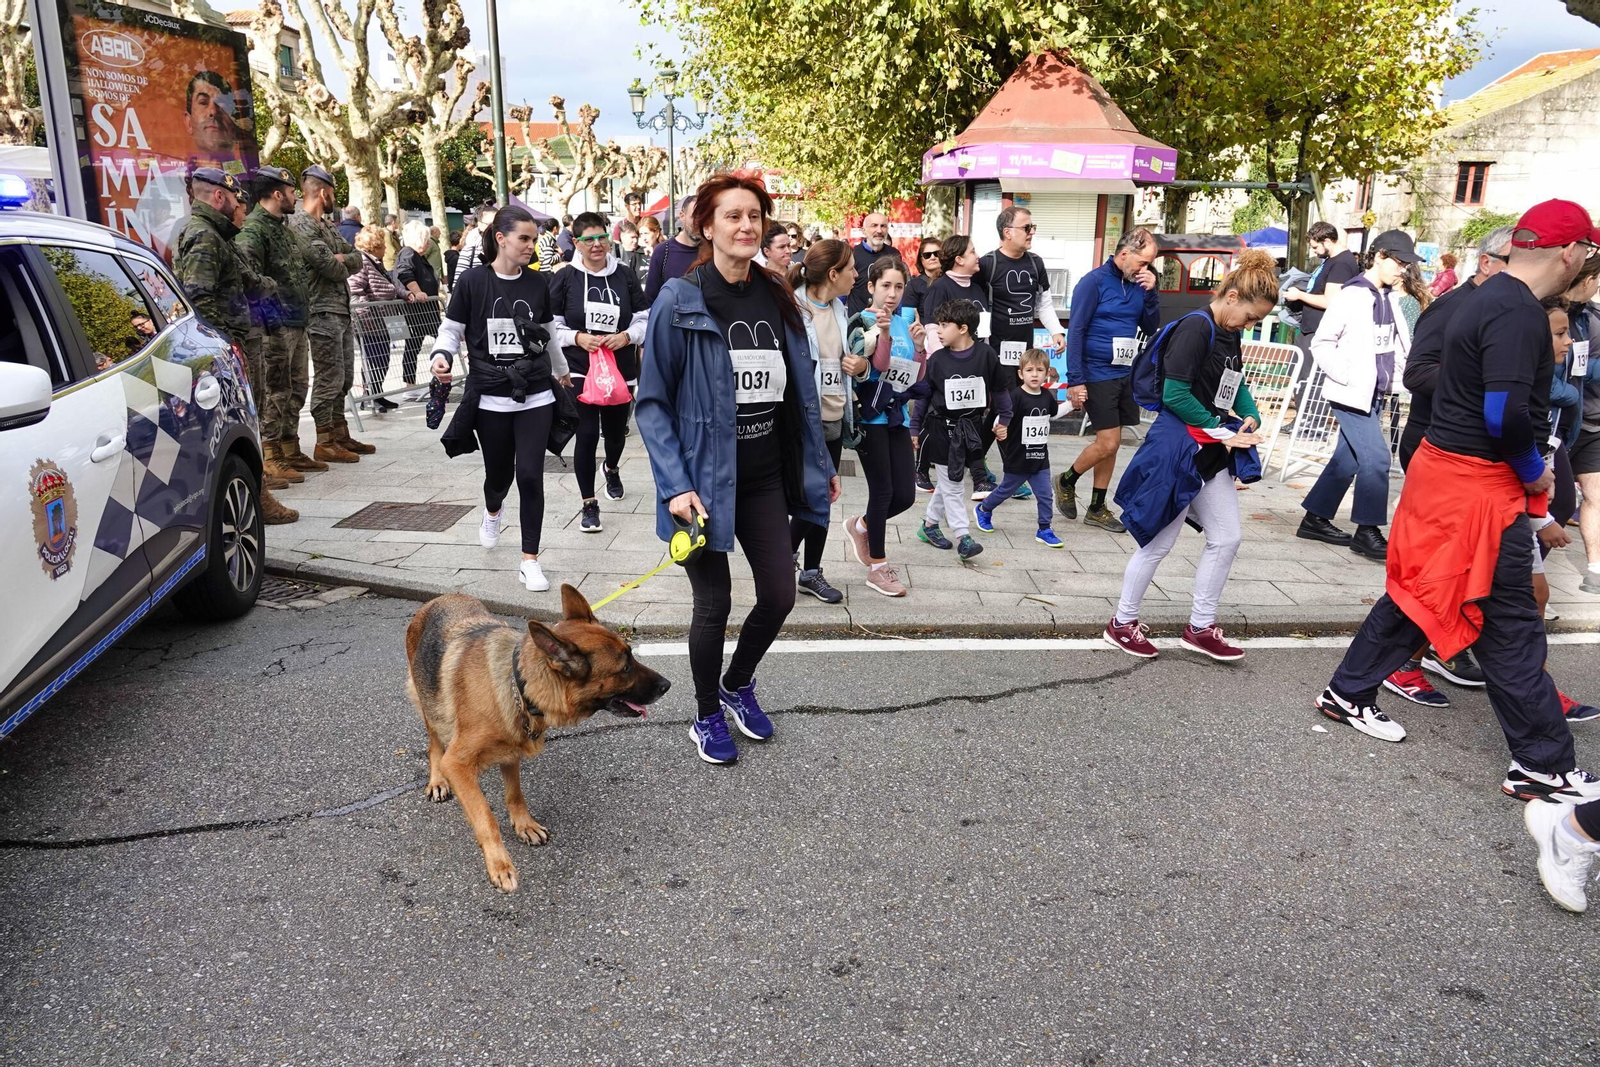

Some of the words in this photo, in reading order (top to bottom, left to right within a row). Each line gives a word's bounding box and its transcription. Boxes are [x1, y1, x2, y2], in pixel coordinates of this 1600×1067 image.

[144, 14, 180, 30] JCDecaux
[90, 34, 138, 61] ABRIL
[86, 68, 105, 78] NON
[106, 71, 137, 83] SOMOS
[137, 76, 149, 86] DE
[87, 78, 142, 94] HALLOWEEN,
[88, 89, 119, 100] SOMOS
[119, 93, 131, 102] DE
[91, 102, 152, 151] SA
[100, 156, 174, 200] MA
[590, 312, 615, 326] 1222
[493, 332, 522, 345] 122
[1004, 350, 1023, 360] 1133
[1116, 347, 1134, 359] 1343
[1578, 354, 1588, 368] 13
[733, 370, 770, 391] 1031
[821, 372, 842, 386] 134
[884, 368, 911, 386] 1342
[950, 389, 975, 401] 1341
[1218, 383, 1235, 400] 1059
[1026, 426, 1049, 437] 1340
